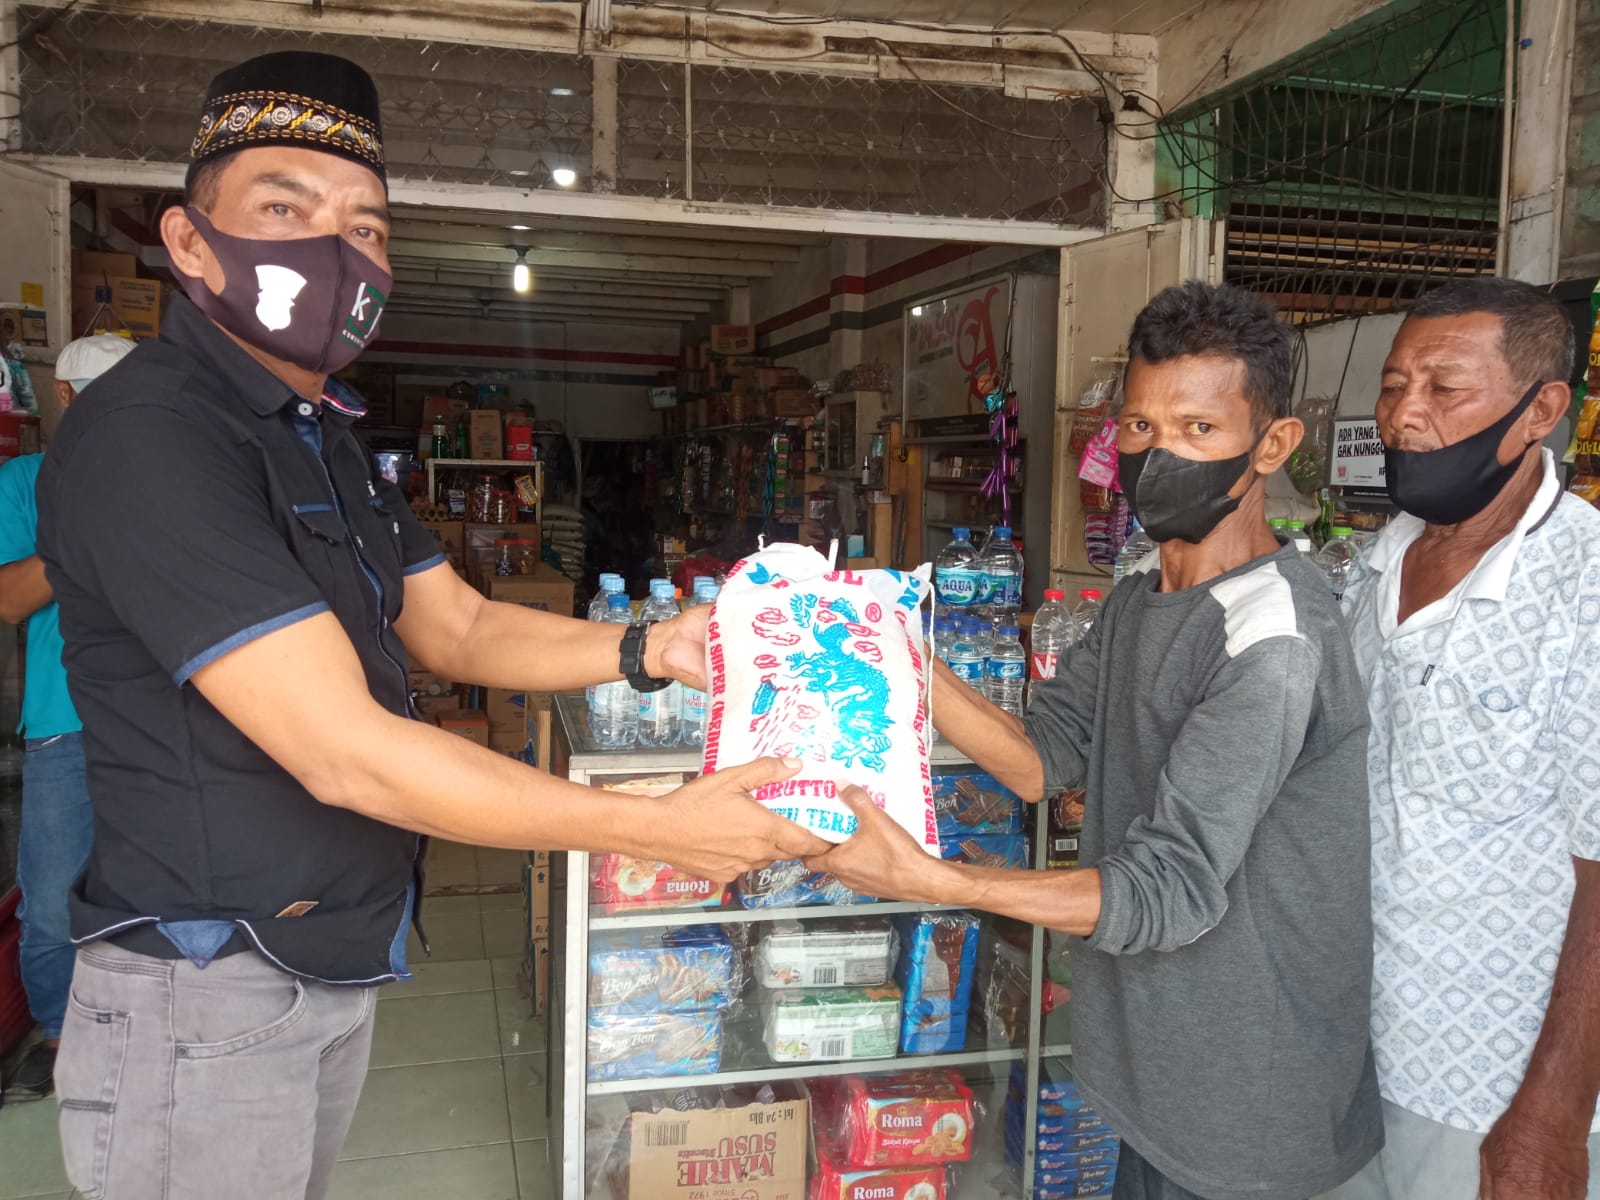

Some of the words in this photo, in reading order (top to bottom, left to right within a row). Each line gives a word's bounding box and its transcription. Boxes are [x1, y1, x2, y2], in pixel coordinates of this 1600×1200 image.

[1338, 428, 1352, 442] ADA
[1354, 426, 1374, 441] YANG
[1337, 444, 1352, 457] GAK
[942, 579, 973, 593] AQUA
[709, 643, 726, 698] SUPER
[755, 779, 838, 800] BRUTTO
[922, 786, 938, 846] BERAS
[666, 880, 710, 894] Roma
[748, 1112, 764, 1125] Bks
[881, 1113, 923, 1128] Roma
[717, 1131, 777, 1158] SUSU
[677, 1151, 776, 1187] MARIE
[854, 1186, 895, 1200] Roma
